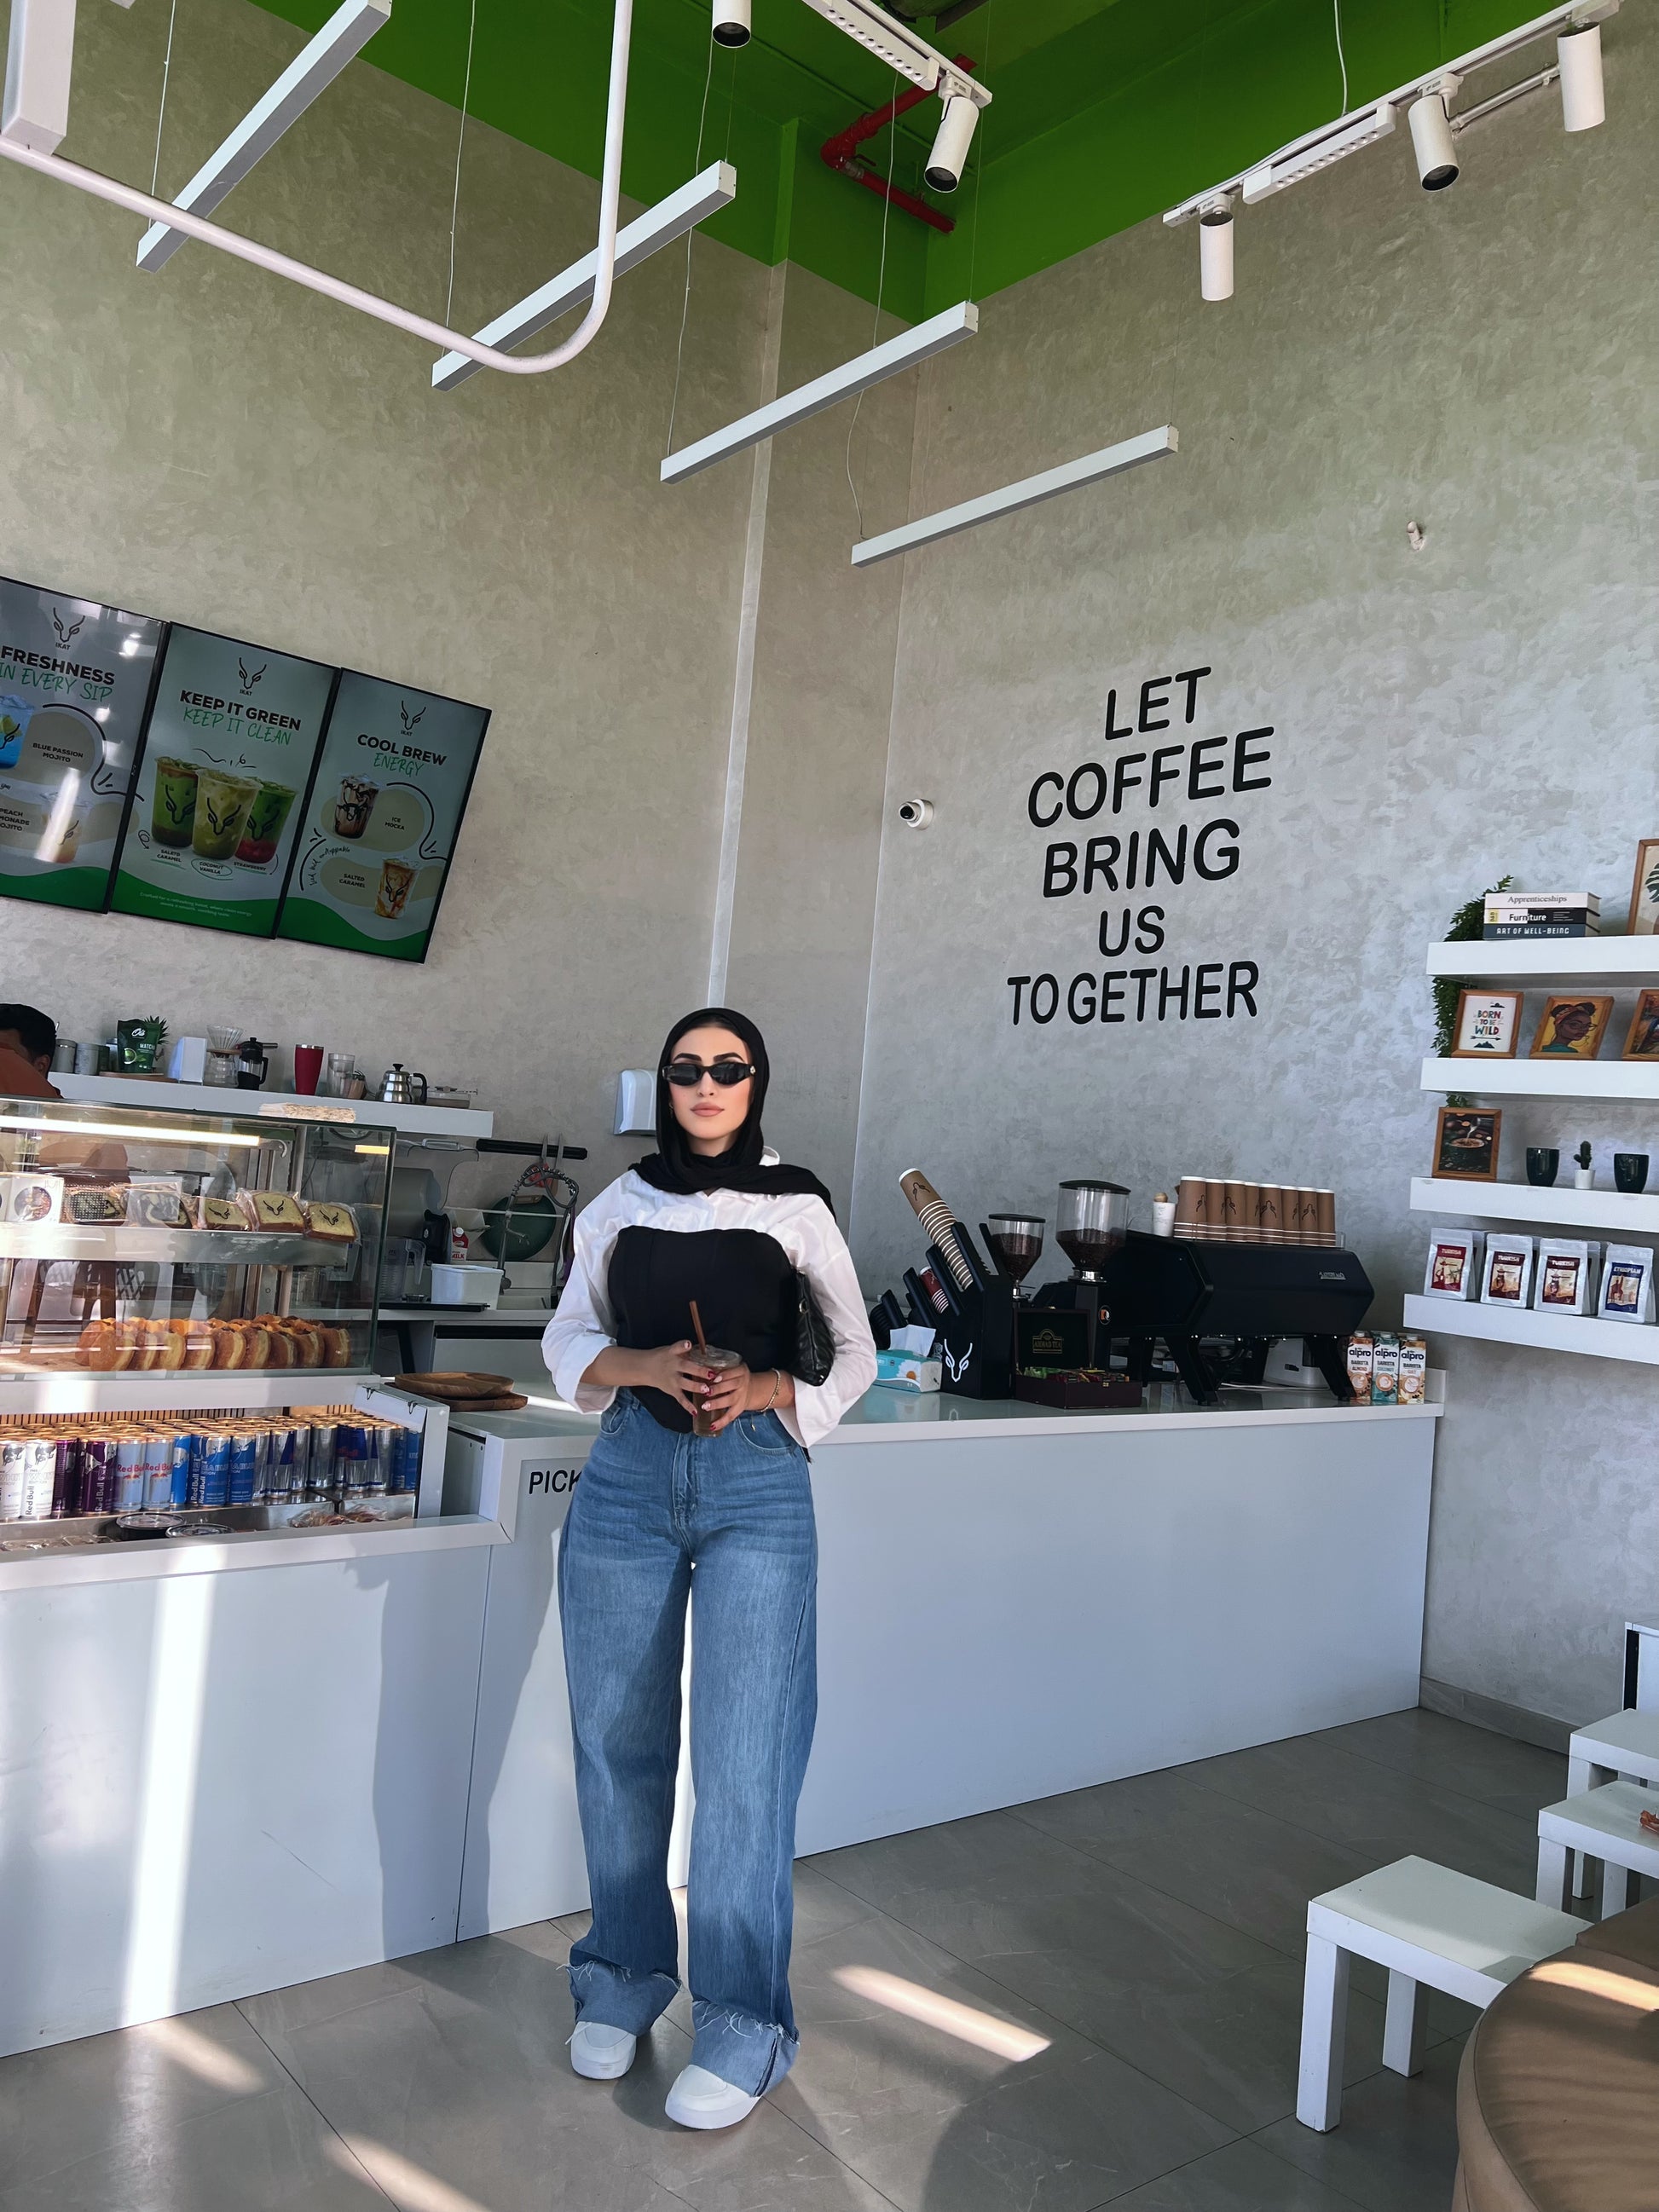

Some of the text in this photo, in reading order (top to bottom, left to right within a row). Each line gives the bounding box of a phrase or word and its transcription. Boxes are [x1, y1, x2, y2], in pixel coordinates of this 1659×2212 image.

[1, 645, 115, 685] FRESHNESS
[21, 668, 78, 695] EVERY
[79, 683, 113, 702] SIP
[180, 690, 302, 731] KEEP IT GREEN
[1106, 667, 1211, 740] LET
[183, 707, 292, 746] KEEP IT CLEAN
[32, 742, 84, 758] BLUE PASSION
[357, 734, 448, 765] COOL BREW
[43, 752, 71, 763] MOJITO
[373, 753, 425, 777] ENERGY
[1028, 726, 1275, 828] COFFEE
[199, 861, 224, 869] COCONUT
[1043, 818, 1240, 898] BRING
[234, 861, 267, 871] STRAWBERRY
[339, 879, 366, 888] CARAMEL
[344, 873, 365, 881] SALTED
[1507, 895, 1568, 904] Apprenticeships
[1509, 913, 1546, 921] Furniture
[1099, 905, 1165, 957] US
[1007, 961, 1259, 1025] TOGETHER
[1477, 1010, 1501, 1019] BORN
[1475, 1025, 1500, 1035] WILD
[1349, 1348, 1371, 1358] alpro
[1375, 1349, 1397, 1359] alpro
[1401, 1350, 1425, 1361] alpro
[529, 1470, 581, 1494] PICK
[26, 1486, 35, 1499] Bull
